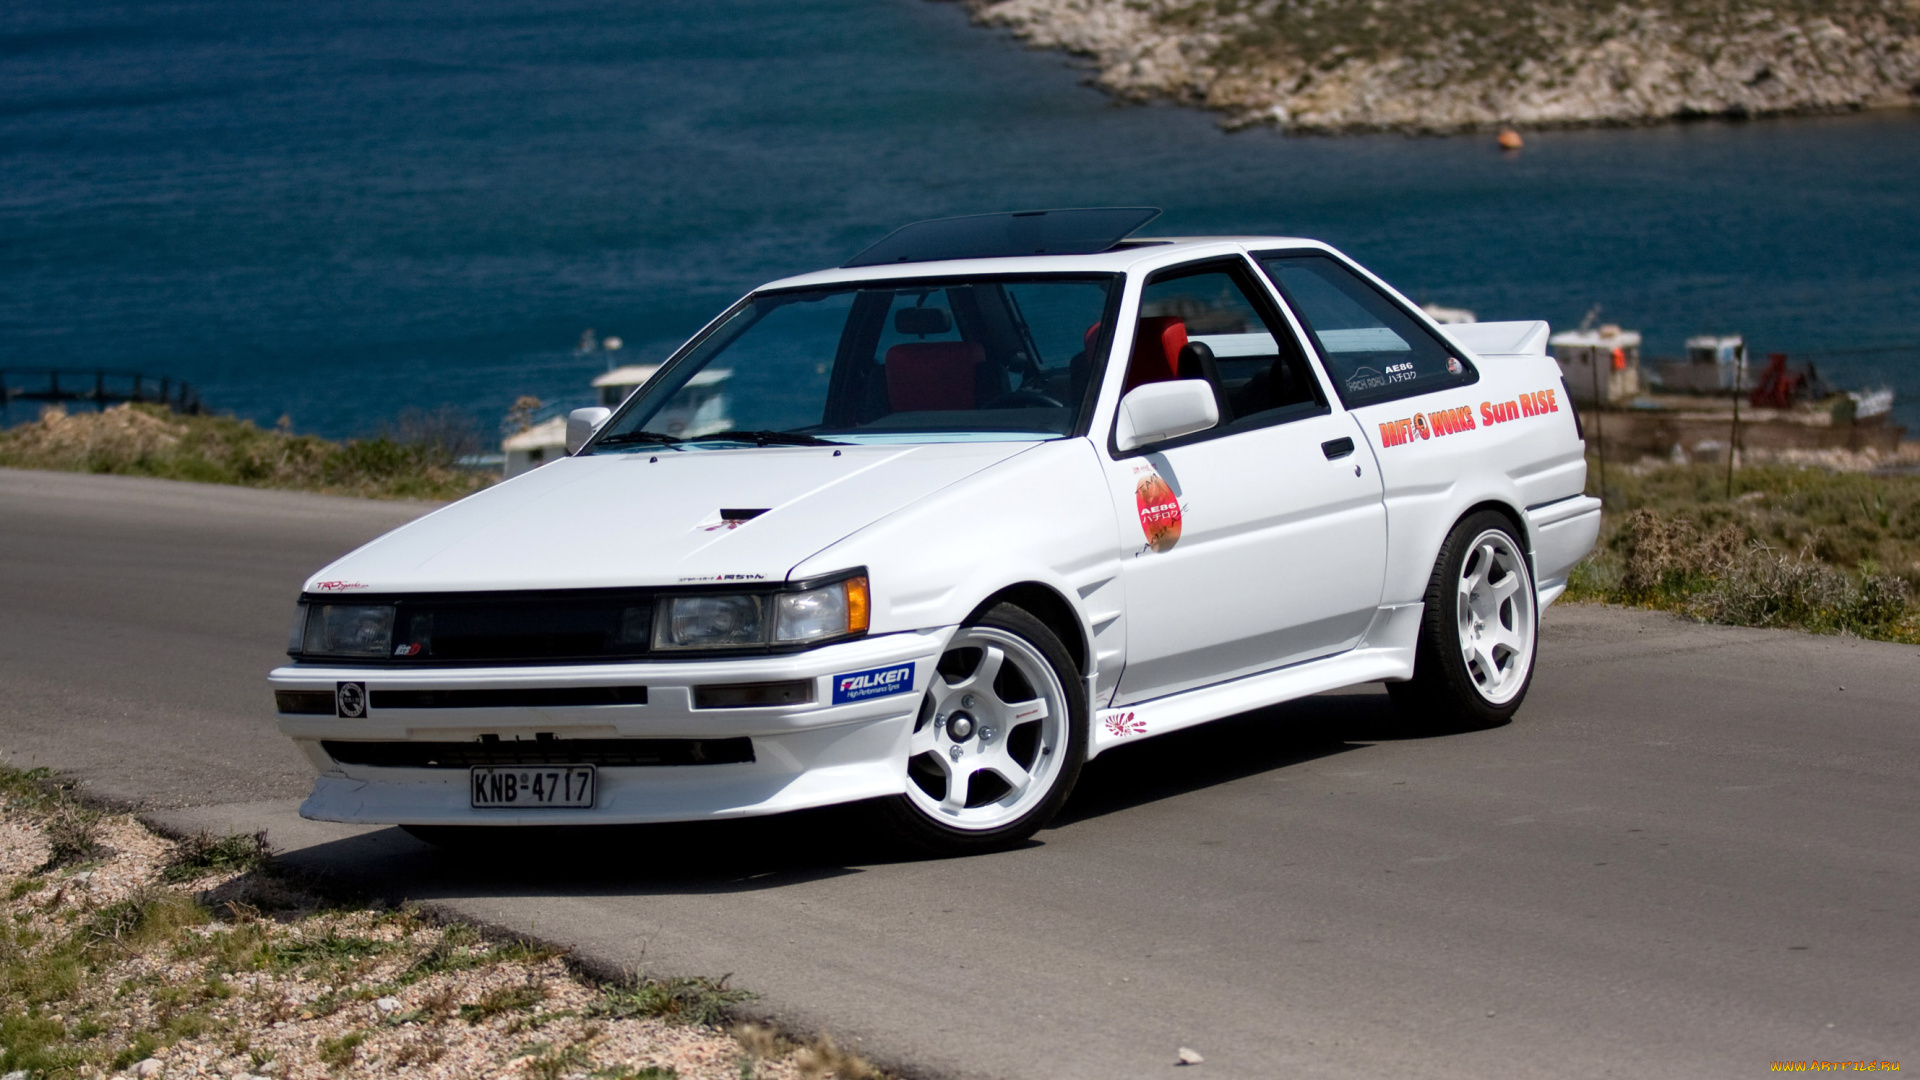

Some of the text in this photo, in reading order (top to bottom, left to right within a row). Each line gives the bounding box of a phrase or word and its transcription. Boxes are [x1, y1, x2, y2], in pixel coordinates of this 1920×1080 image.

[1386, 362, 1413, 374] AE86
[1388, 371, 1417, 384] ハチロク
[1519, 389, 1559, 418] RISE
[1379, 405, 1476, 448] DRIFT WORKS
[1141, 502, 1177, 515] AE86
[1142, 510, 1179, 523] ハチロク
